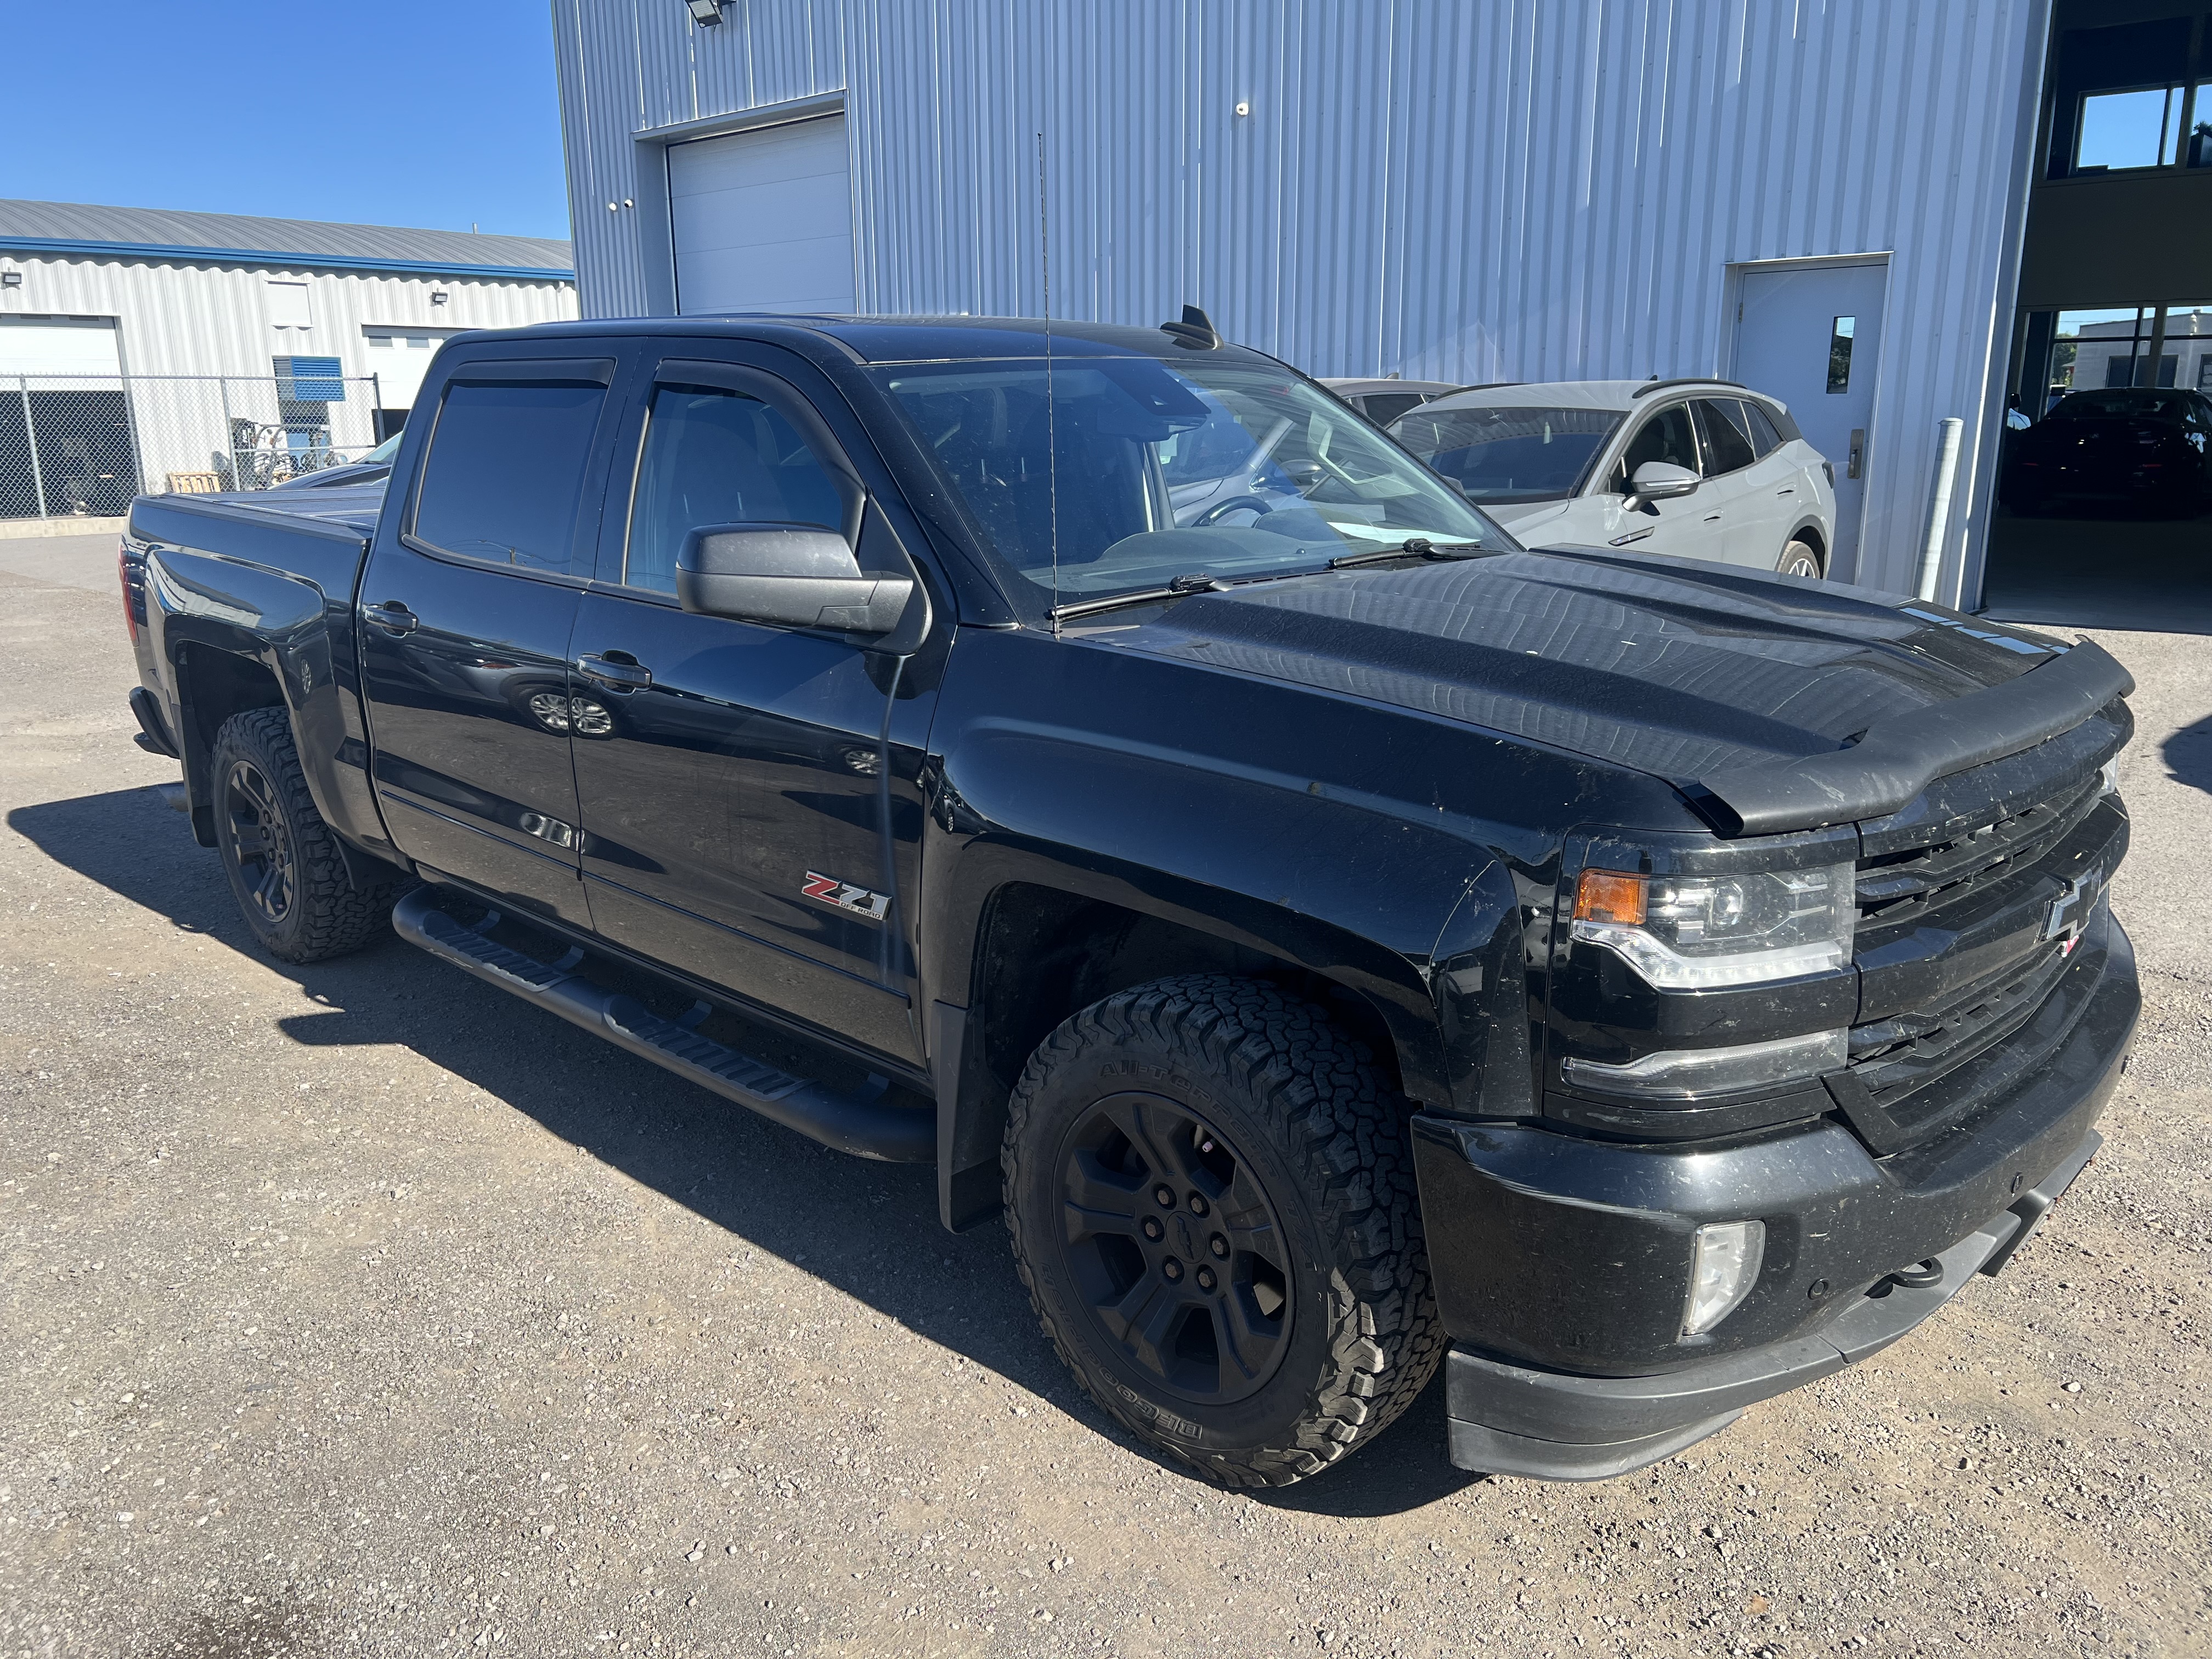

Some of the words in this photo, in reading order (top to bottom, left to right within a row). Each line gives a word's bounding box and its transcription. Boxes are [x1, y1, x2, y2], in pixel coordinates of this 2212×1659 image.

[801, 870, 892, 915] Z71
[840, 901, 857, 911] OFF
[857, 907, 881, 919] ROAD
